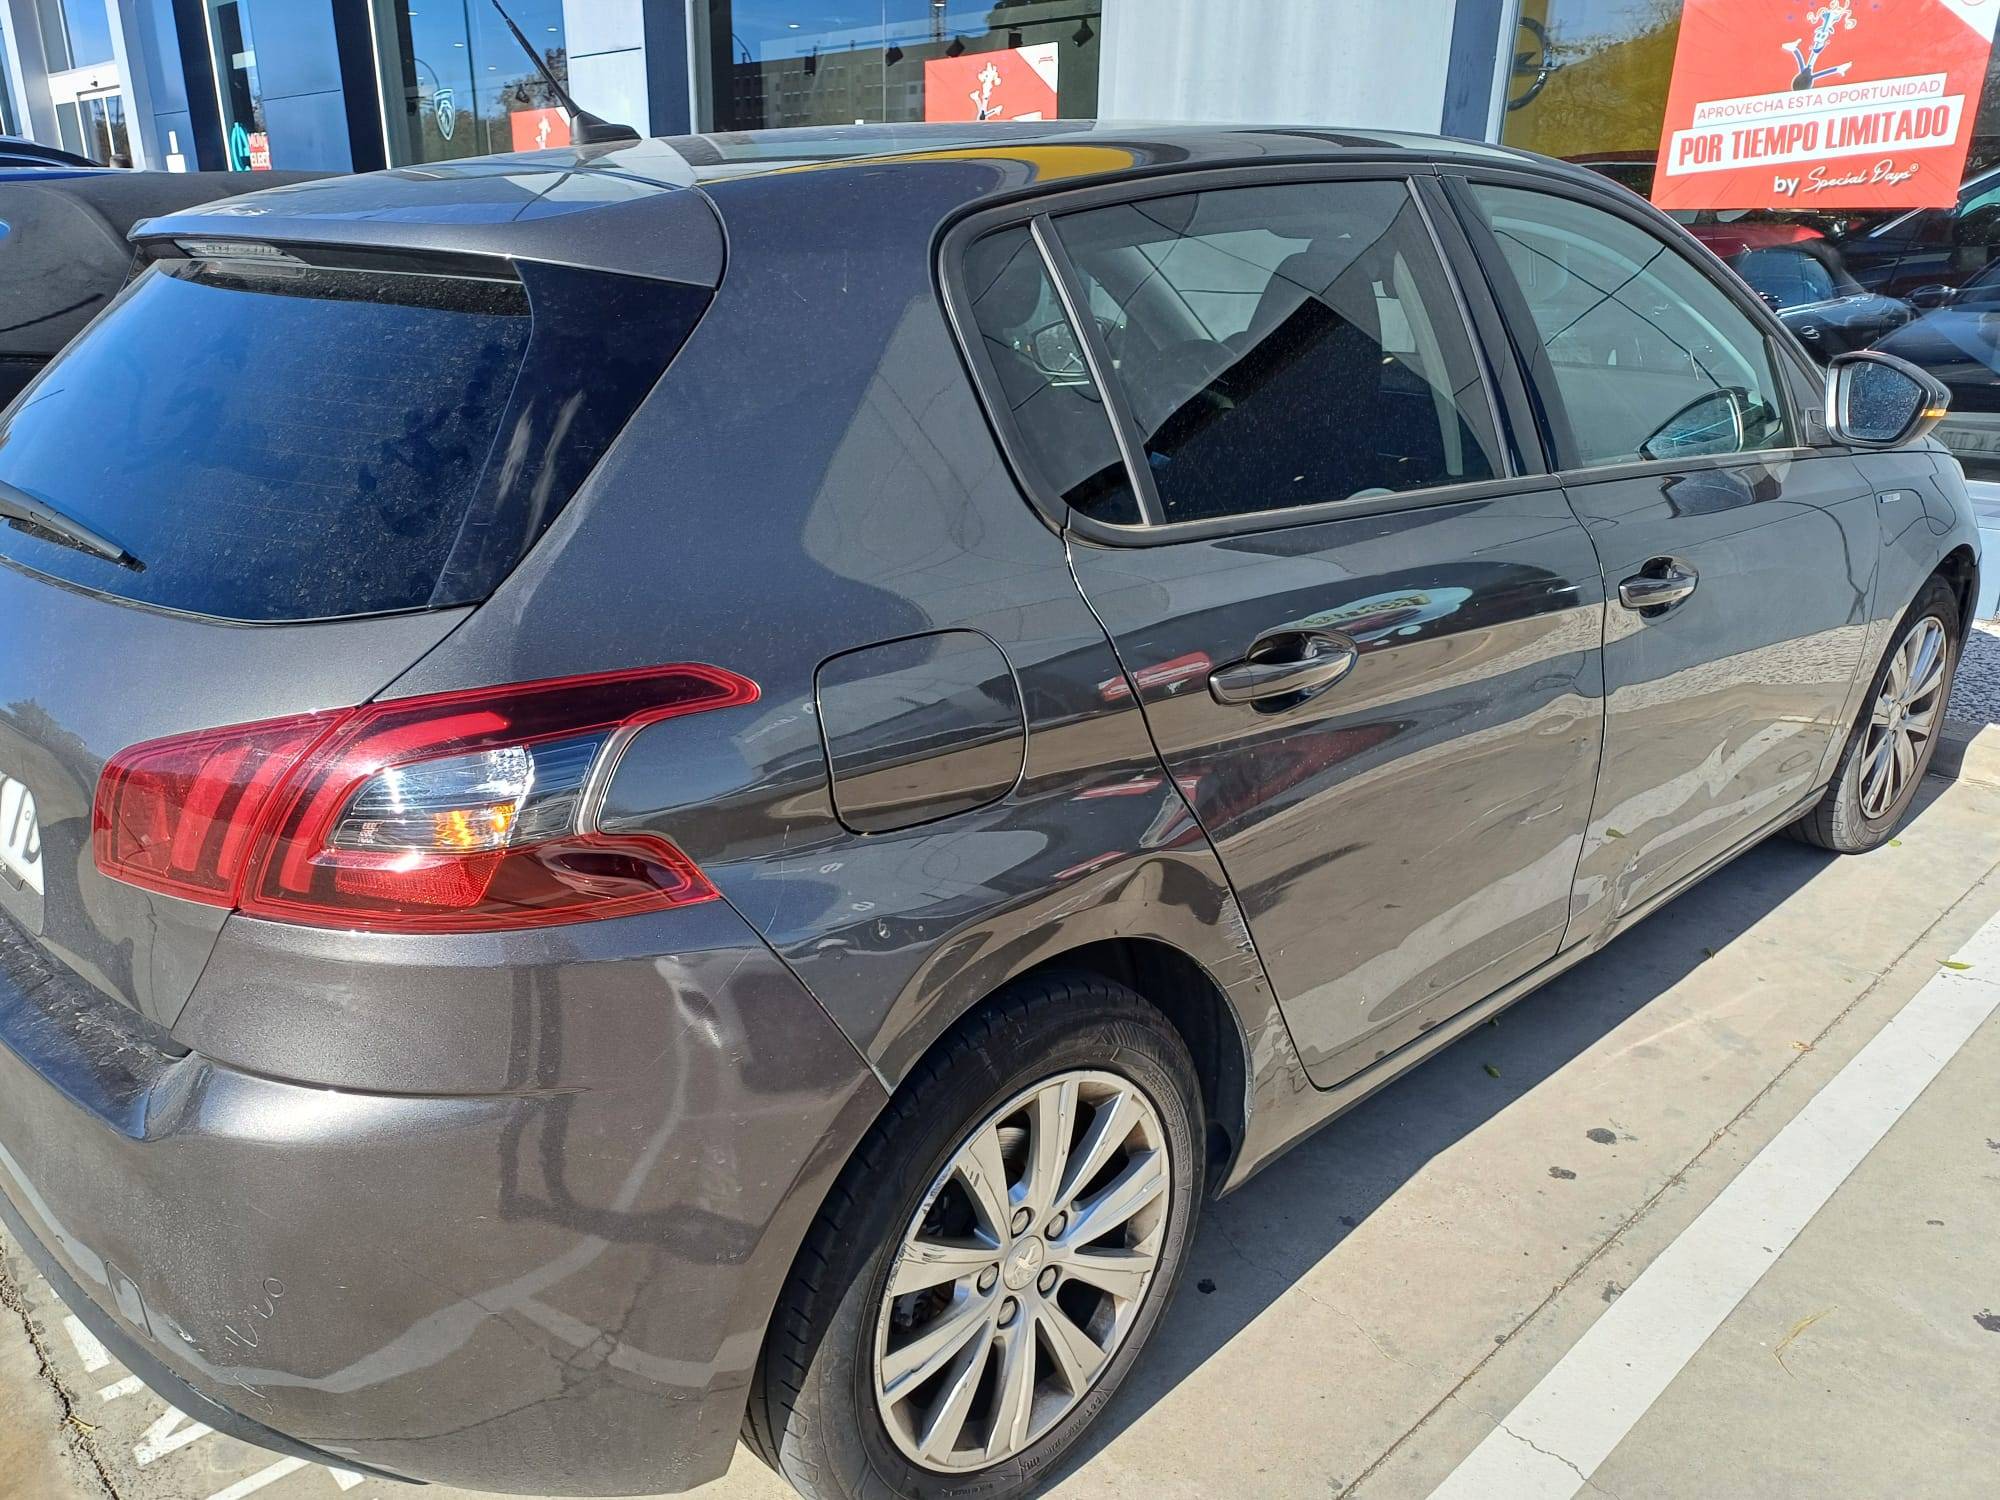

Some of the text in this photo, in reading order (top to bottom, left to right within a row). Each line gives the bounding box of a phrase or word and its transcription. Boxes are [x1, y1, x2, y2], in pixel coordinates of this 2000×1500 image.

[1697, 80, 1941, 120] APROVECHA ESTA OPORTUNIDAD
[1678, 105, 1951, 166] POR TIEMPO LIMITADO
[1773, 175, 1800, 196] by
[1803, 166, 1867, 192] Special
